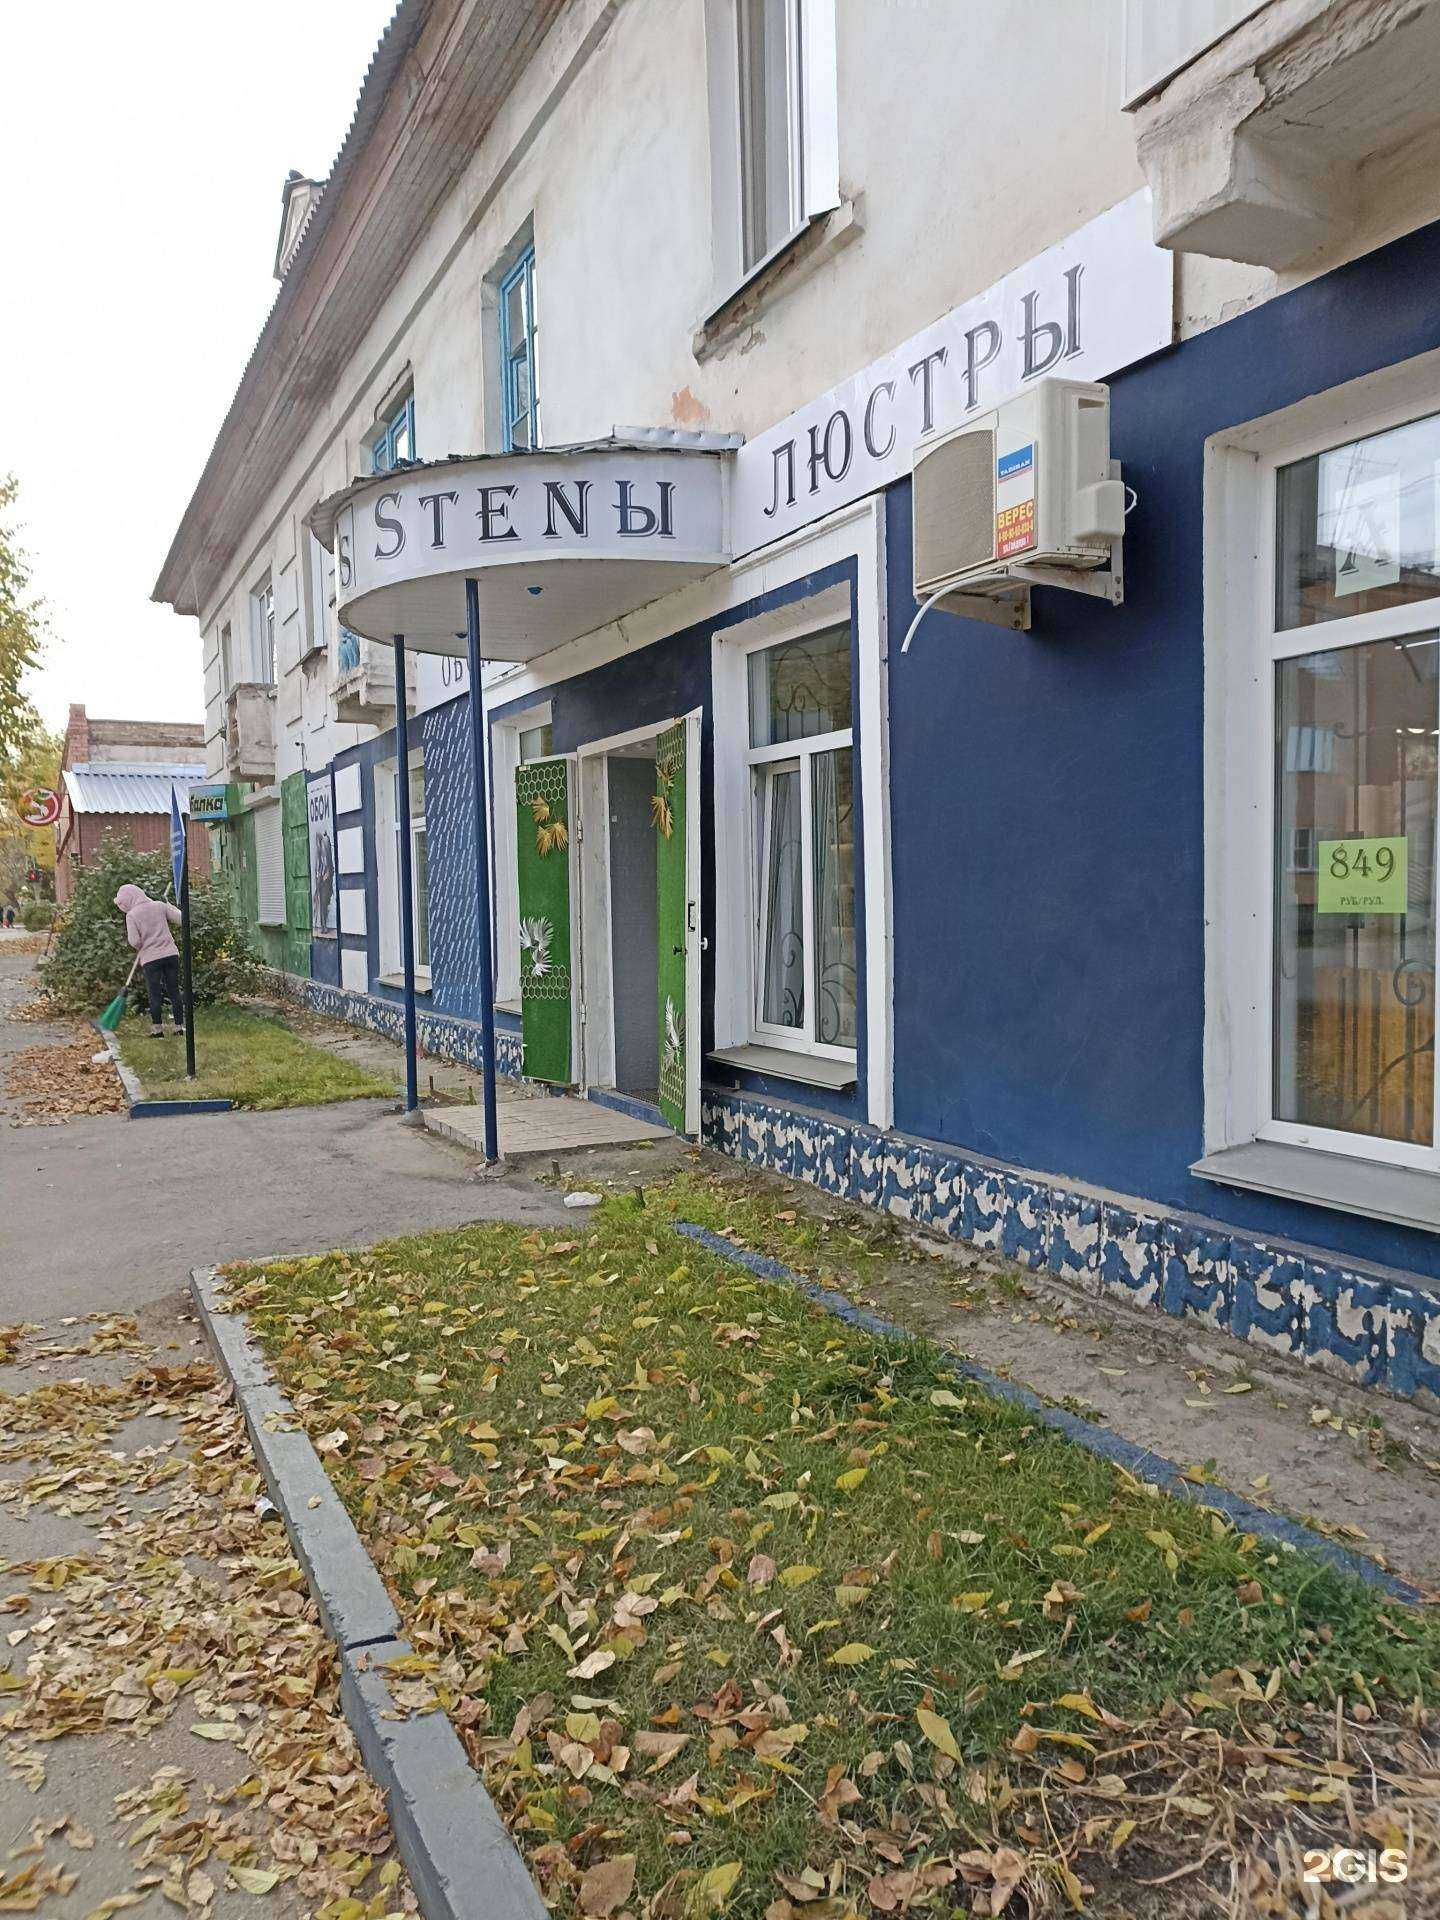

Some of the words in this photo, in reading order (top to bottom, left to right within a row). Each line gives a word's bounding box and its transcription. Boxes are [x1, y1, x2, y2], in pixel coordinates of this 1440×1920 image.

[763, 263, 1084, 517] ЛЮСТРЫ
[374, 480, 676, 560] STENЫ
[310, 794, 330, 822] ОБОИ
[1330, 844, 1394, 883] 849
